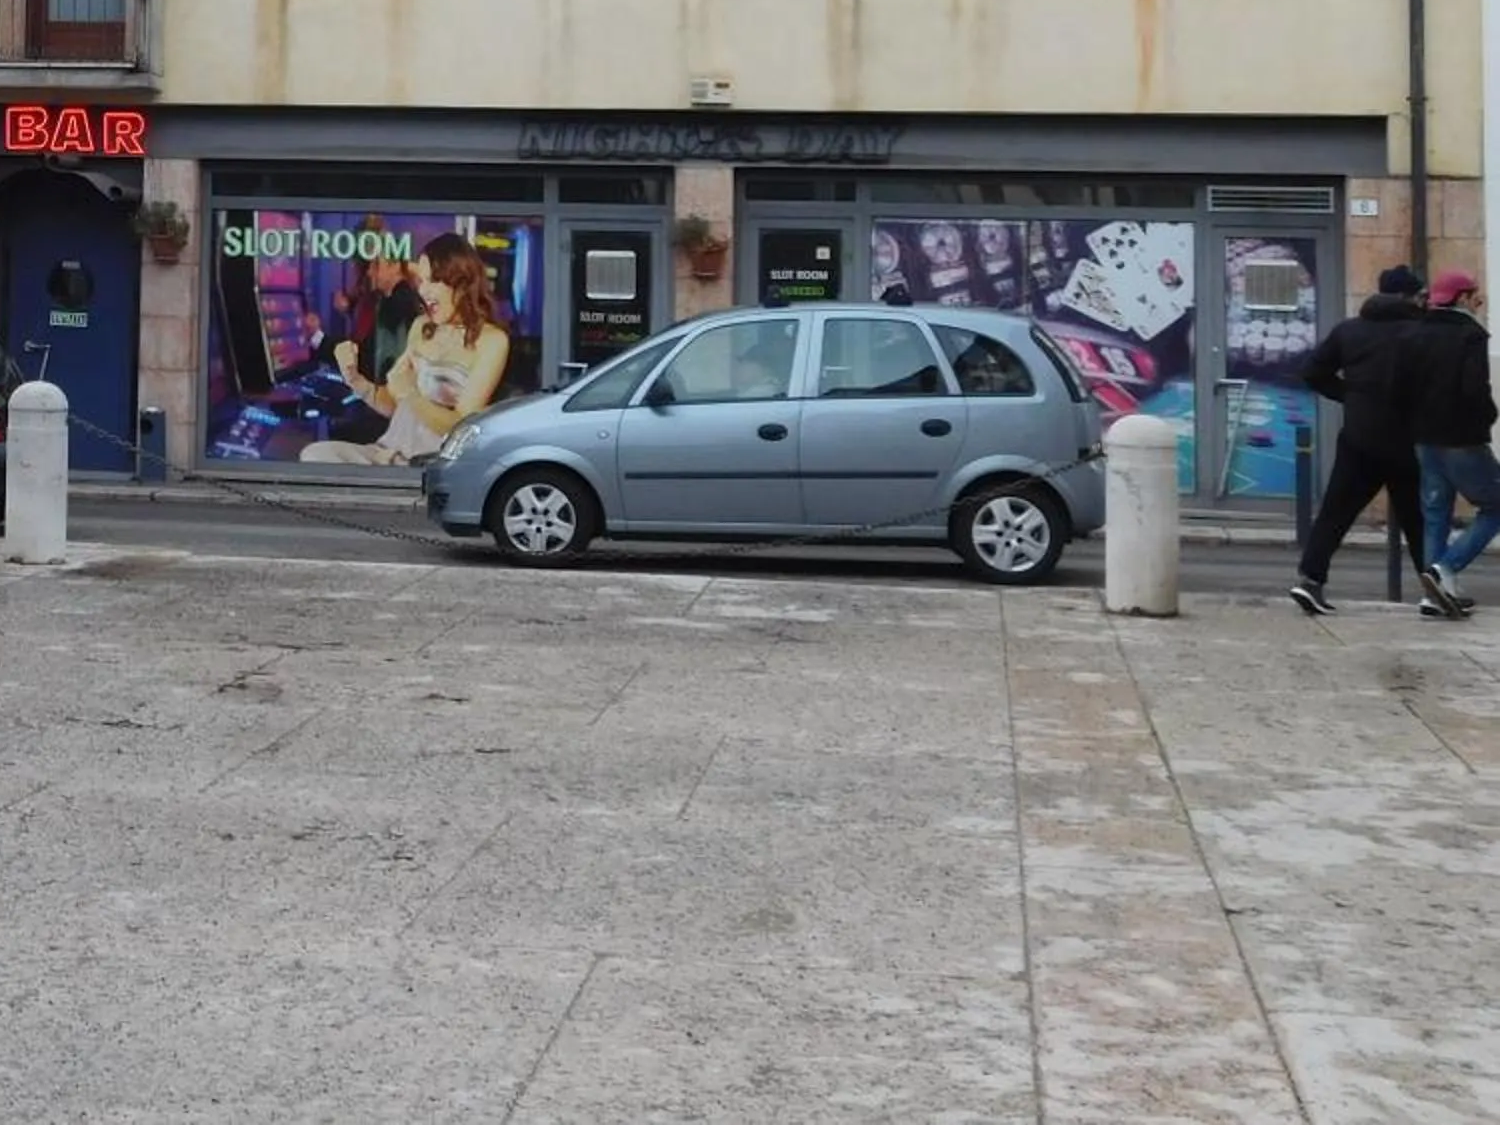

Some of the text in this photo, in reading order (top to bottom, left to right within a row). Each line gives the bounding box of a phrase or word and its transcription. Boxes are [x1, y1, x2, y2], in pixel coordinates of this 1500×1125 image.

[6, 107, 145, 154] BAR
[785, 123, 904, 163] DAY
[224, 226, 412, 260] SLOT ROOM
[796, 270, 829, 280] ROOM
